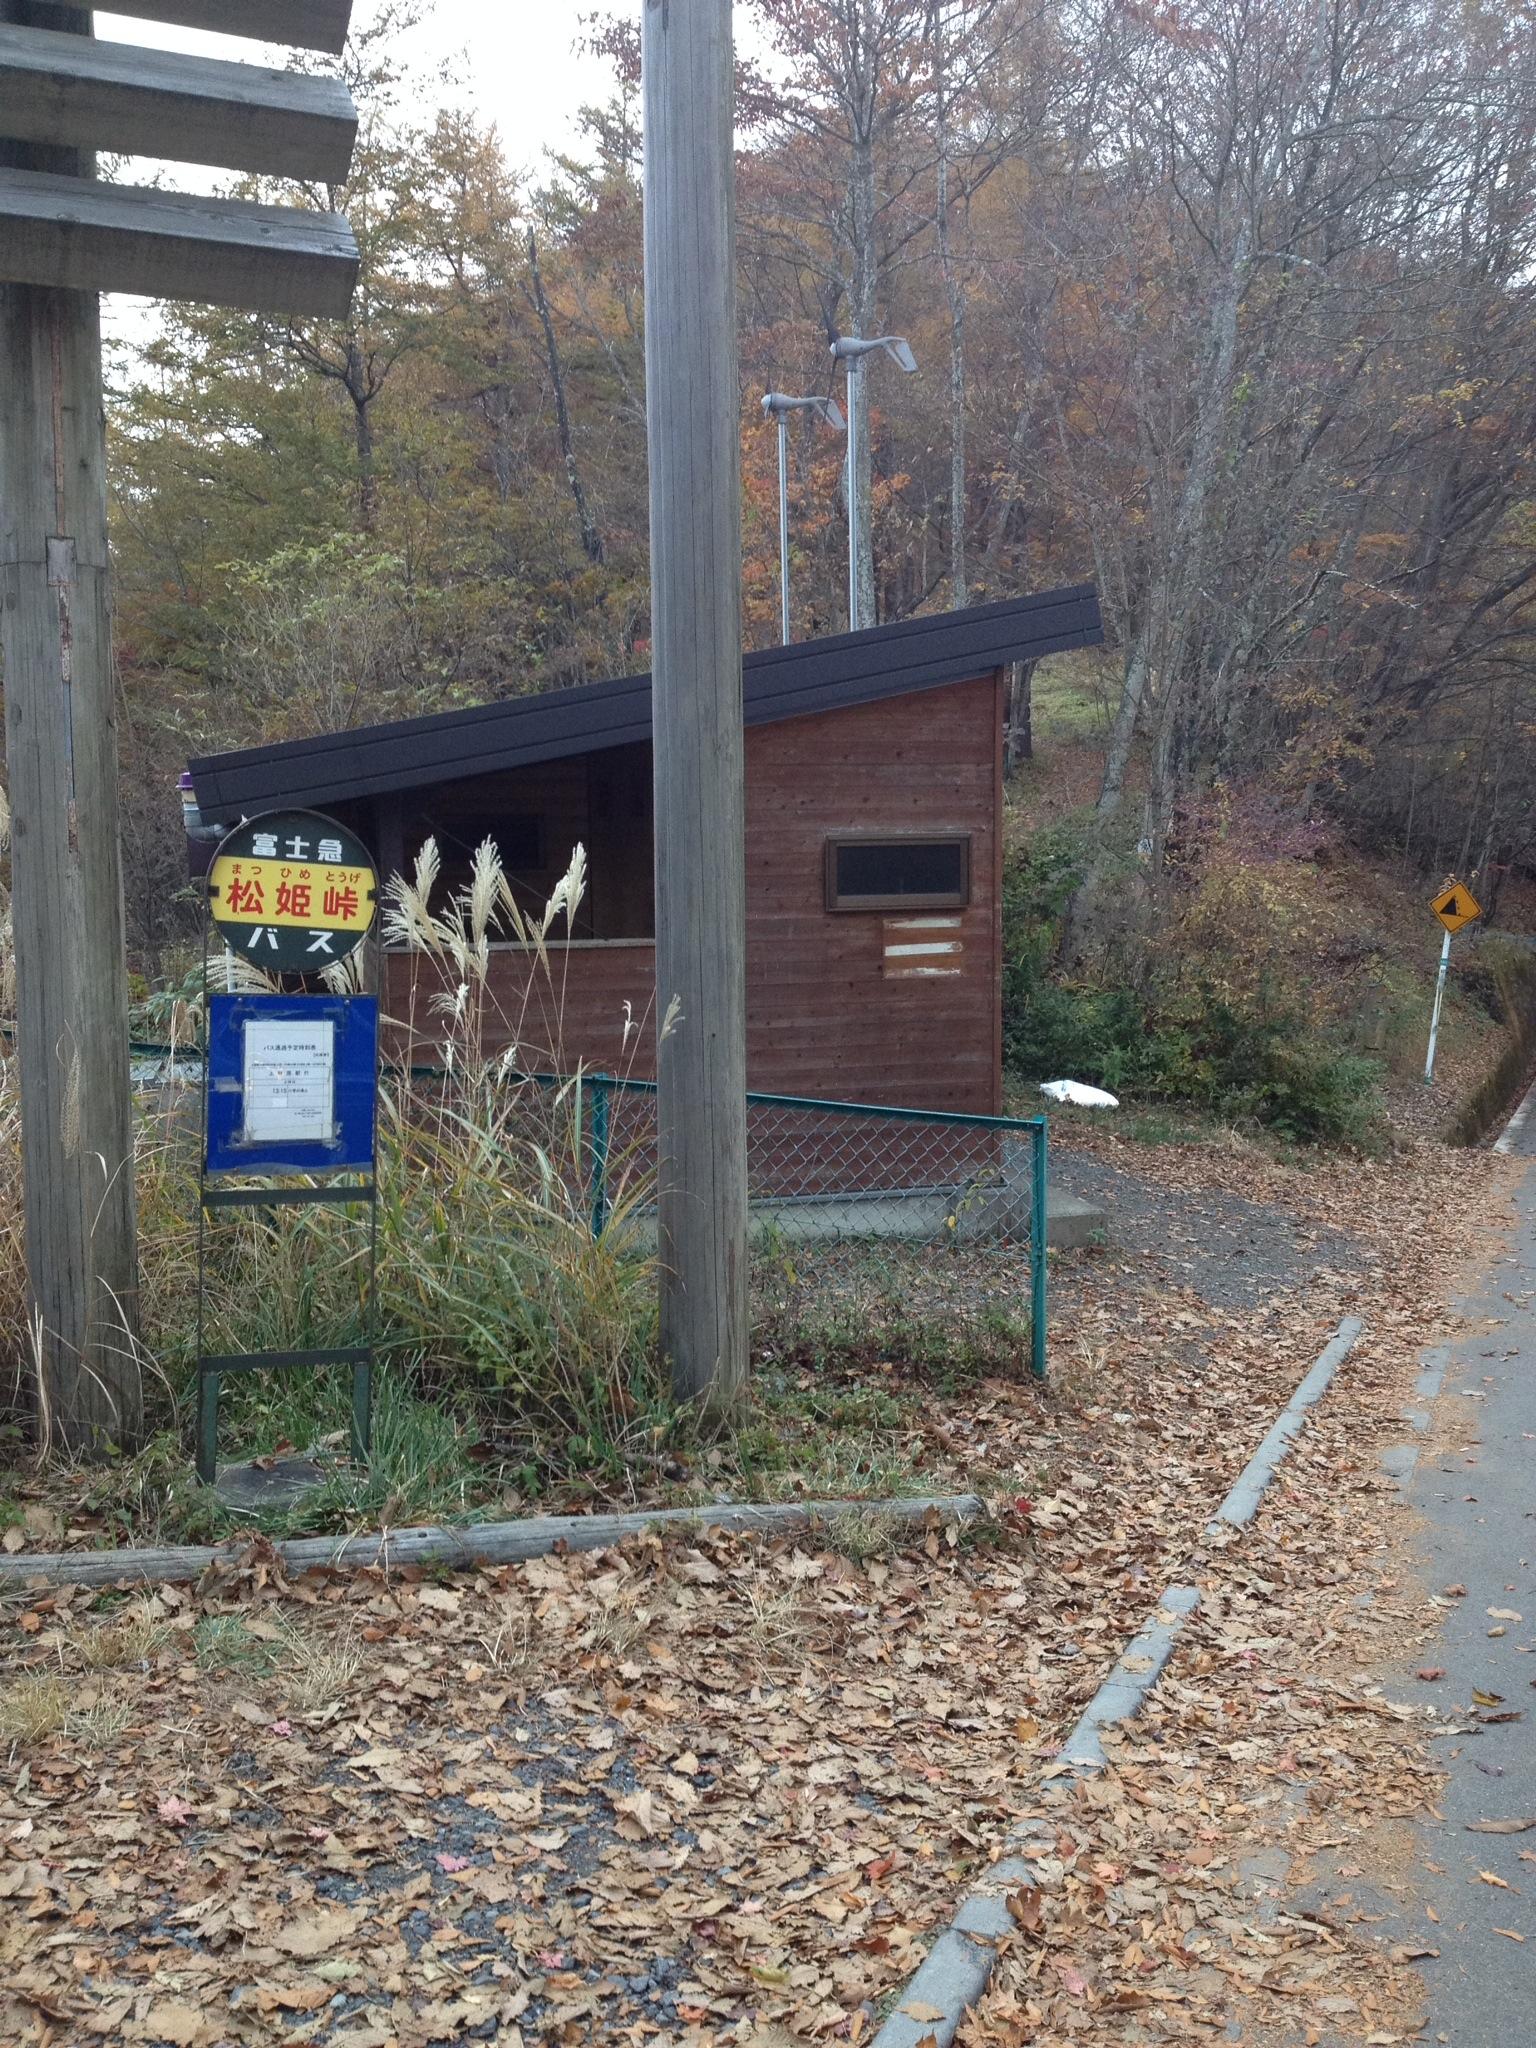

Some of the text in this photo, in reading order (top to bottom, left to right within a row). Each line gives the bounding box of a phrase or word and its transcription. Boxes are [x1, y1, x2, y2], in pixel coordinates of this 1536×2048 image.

[252, 833, 343, 862] 富士急
[226, 878, 358, 920] 松姫峠
[247, 927, 334, 953] バス
